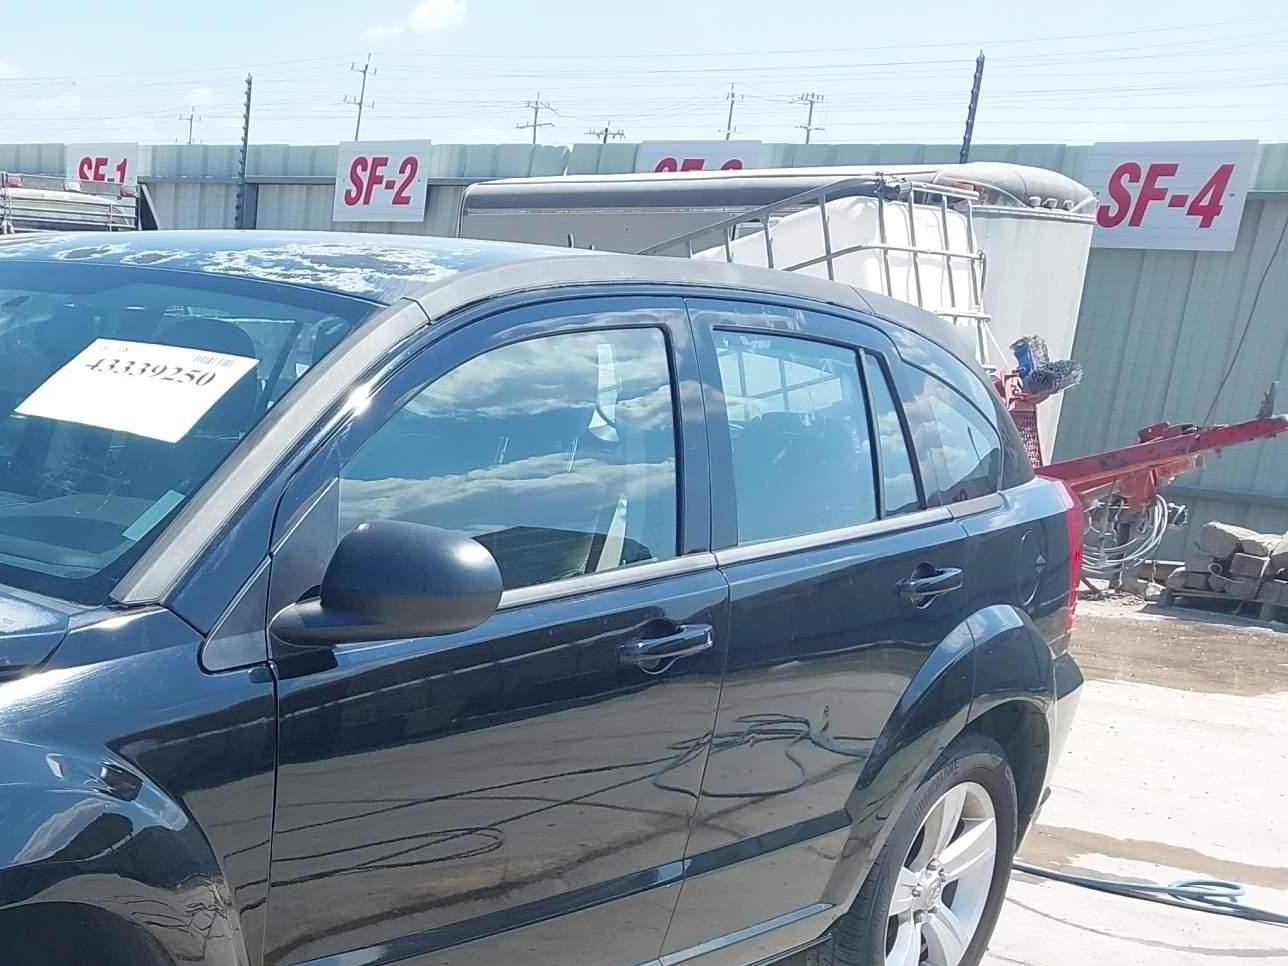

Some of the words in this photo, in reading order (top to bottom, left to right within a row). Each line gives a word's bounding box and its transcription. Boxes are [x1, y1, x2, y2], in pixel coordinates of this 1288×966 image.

[344, 156, 419, 206] SF-2
[1096, 161, 1235, 228] SF-4
[84, 357, 217, 387] 43339250
